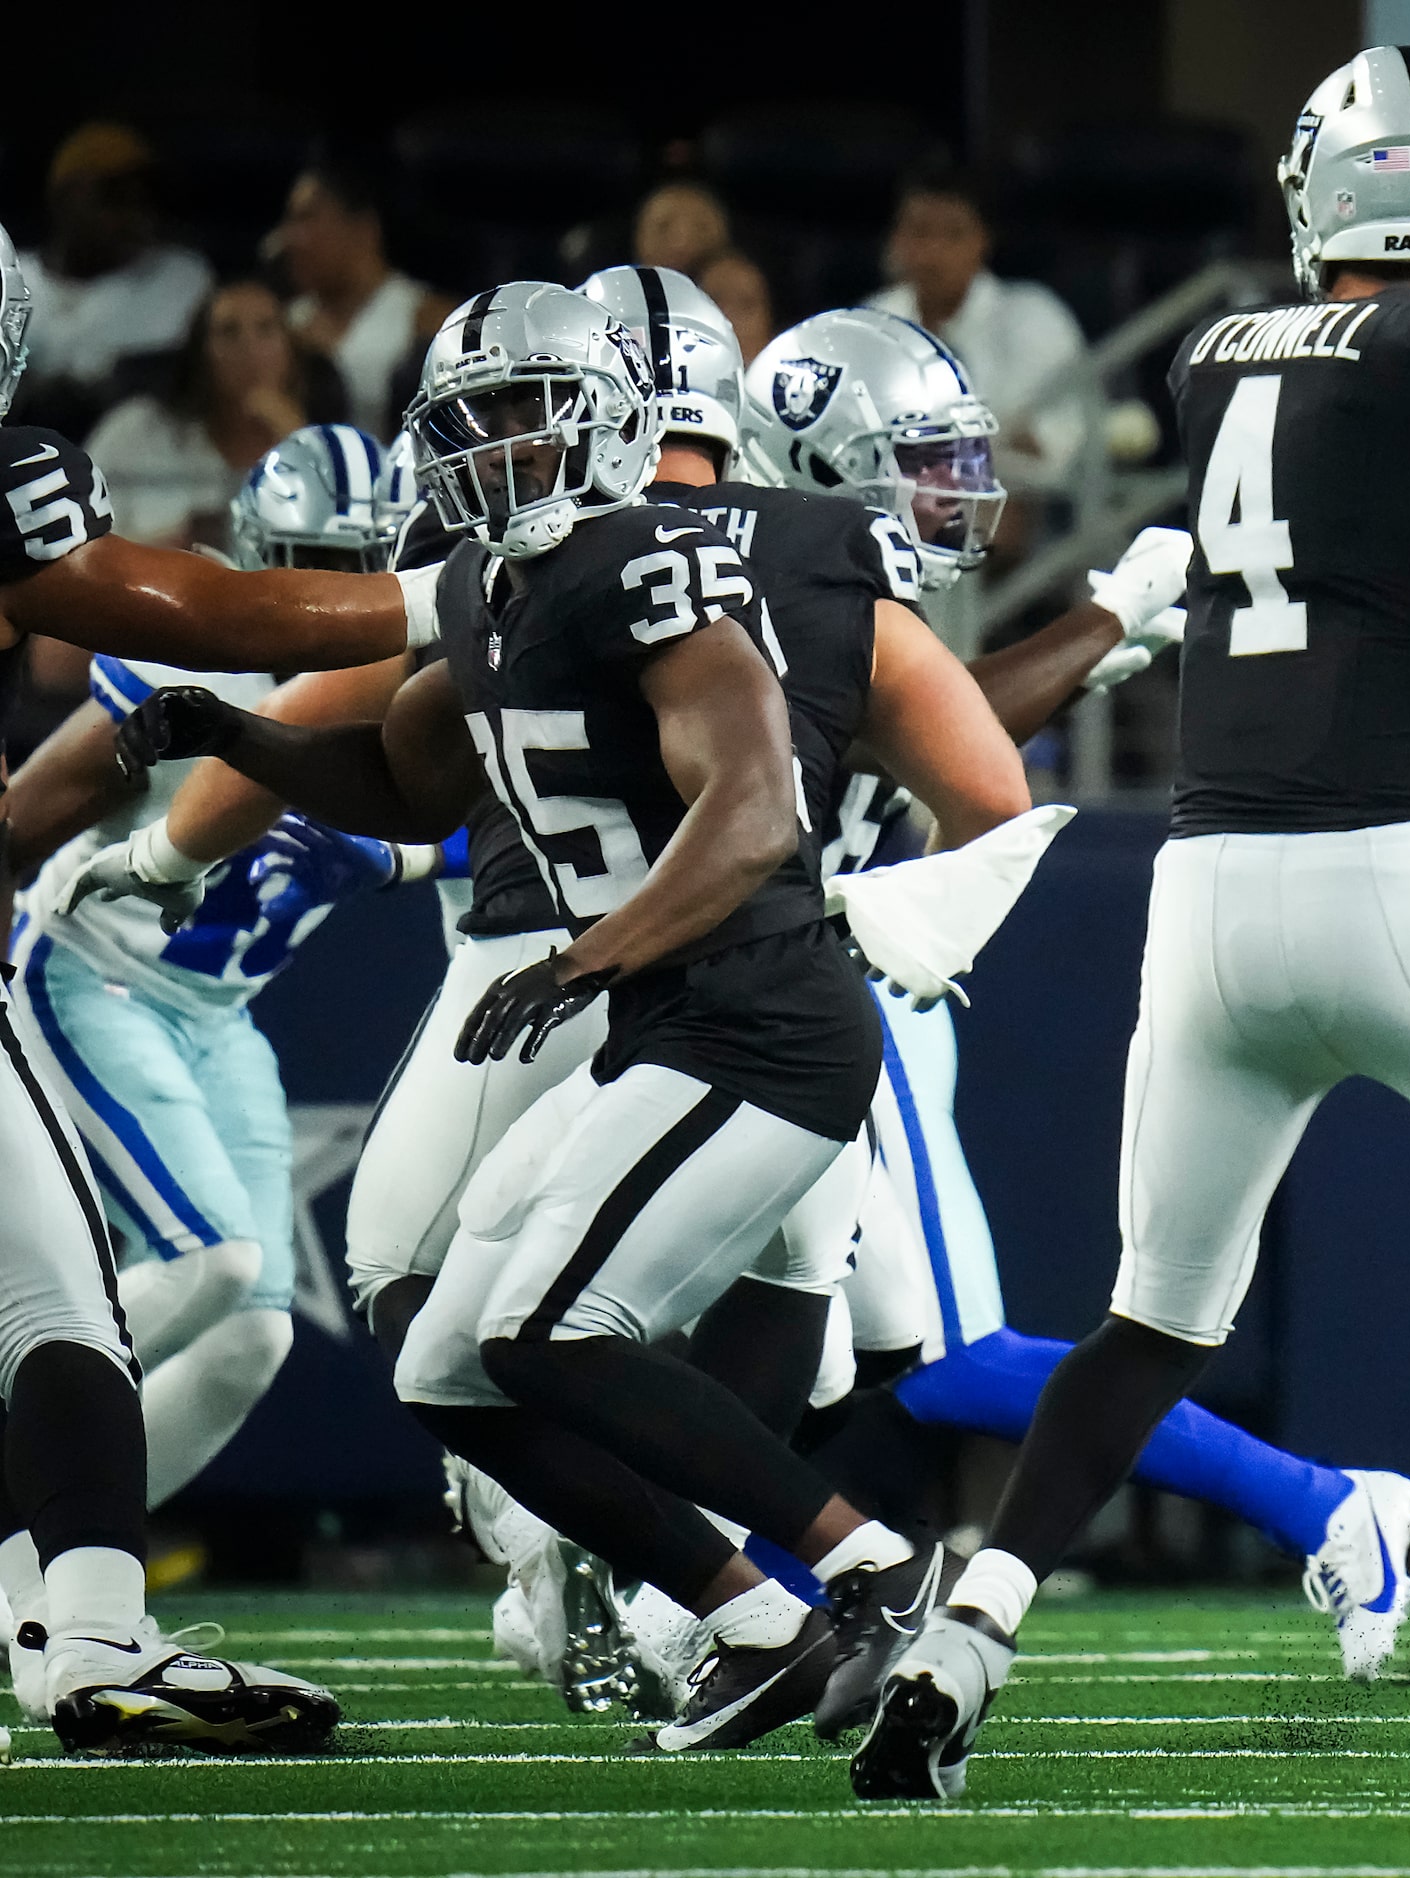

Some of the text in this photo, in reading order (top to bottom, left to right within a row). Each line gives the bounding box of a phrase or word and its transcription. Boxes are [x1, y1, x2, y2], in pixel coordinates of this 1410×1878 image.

[1189, 303, 1379, 365] O'CONNELL
[1198, 373, 1308, 656] 4
[621, 545, 754, 645] 35
[464, 708, 650, 918] 5
[170, 1660, 222, 1669] ALPHA
